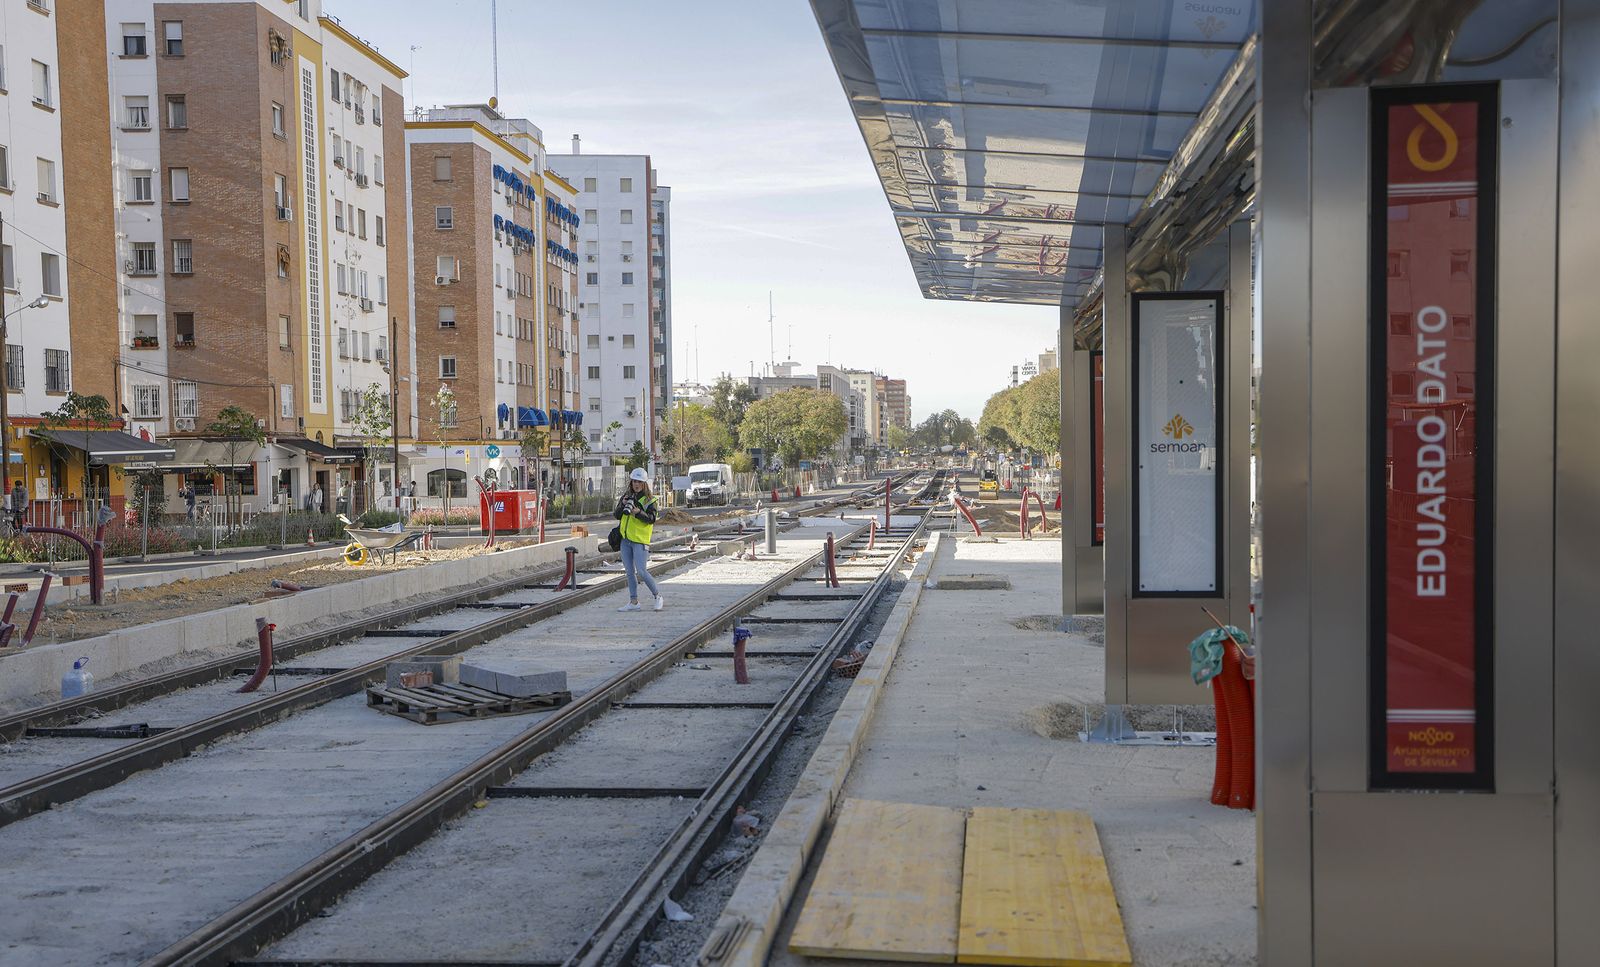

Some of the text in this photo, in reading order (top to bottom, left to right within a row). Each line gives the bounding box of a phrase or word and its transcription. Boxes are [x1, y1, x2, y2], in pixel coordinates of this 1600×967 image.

[487, 448, 499, 456] VK
[1151, 442, 1206, 453] semoan
[1417, 304, 1448, 597] EDUARDO DATO
[1404, 756, 1457, 767] DE SEVILLA
